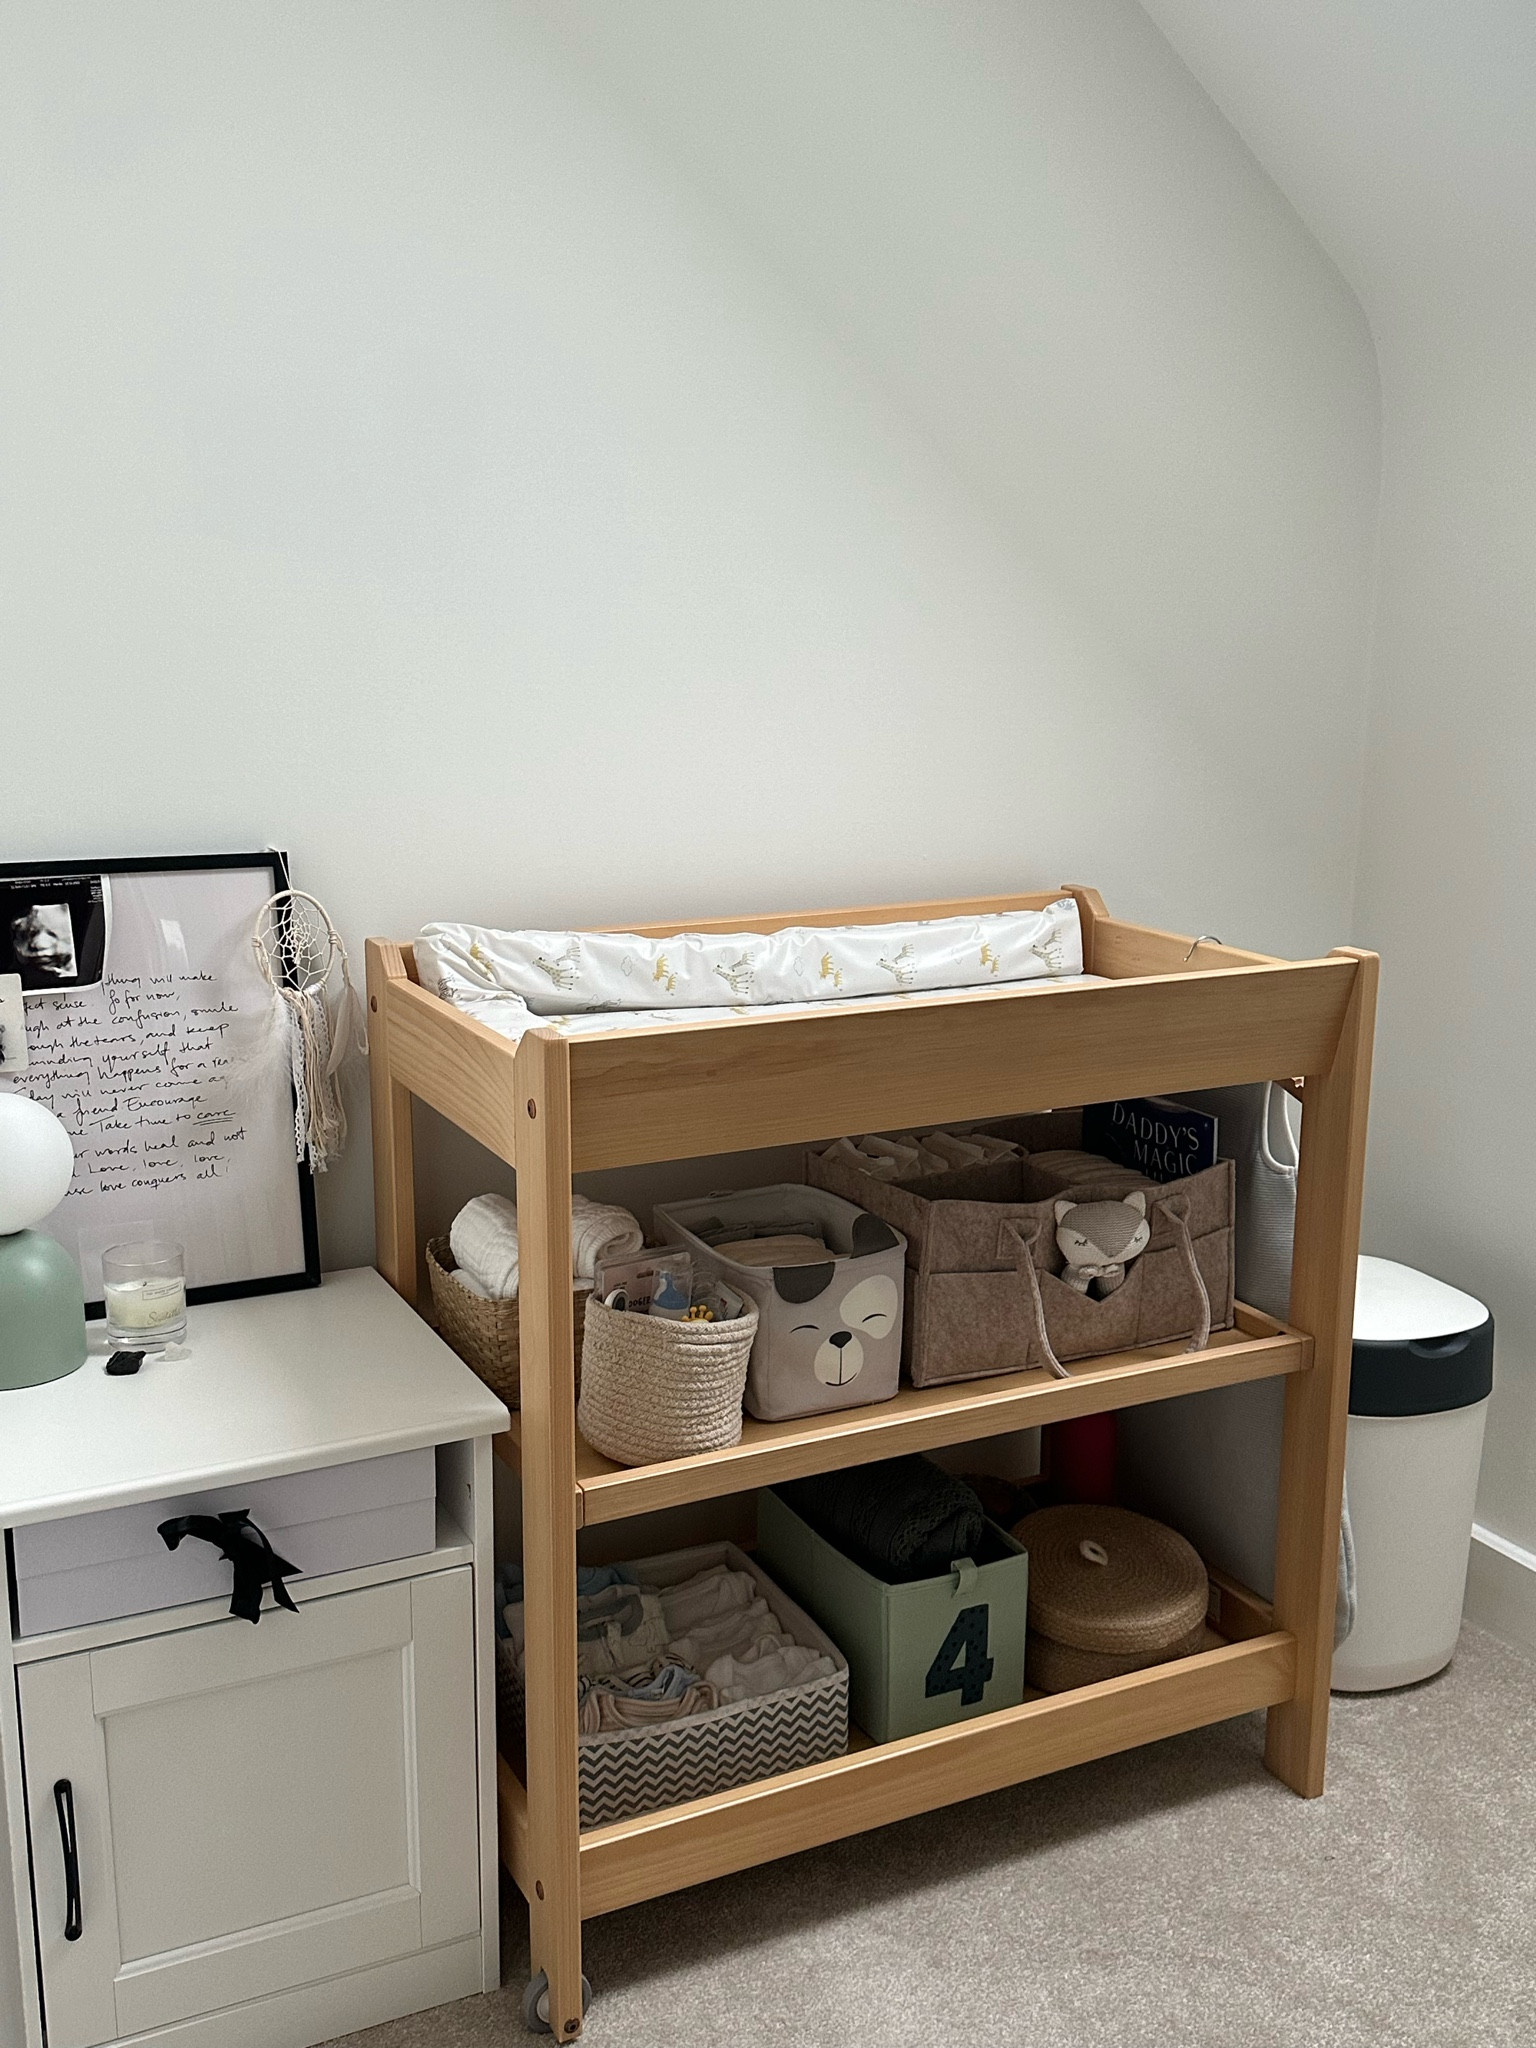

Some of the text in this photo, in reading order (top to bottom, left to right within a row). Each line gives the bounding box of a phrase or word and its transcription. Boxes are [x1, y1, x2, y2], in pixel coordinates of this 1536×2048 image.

[150, 974, 172, 984] will
[179, 970, 217, 981] make
[23, 997, 46, 1016] fect
[125, 989, 140, 1009] for
[25, 1020, 49, 1038] ugh
[57, 1016, 74, 1030] at
[78, 1016, 102, 1027] the
[191, 1002, 238, 1015] smile
[28, 1039, 63, 1054] ough
[69, 1036, 94, 1048] the
[146, 1024, 176, 1038] and
[187, 1023, 229, 1038] keep
[102, 1041, 169, 1073] yourself
[179, 1037, 213, 1053] that
[13, 1070, 90, 1088] everything
[97, 1066, 161, 1082] happens
[170, 1057, 193, 1077] for
[62, 1089, 92, 1099] will
[100, 1083, 150, 1095] never
[155, 1079, 203, 1088] come
[123, 1096, 208, 1112] Encourage
[89, 1115, 132, 1133] Take
[135, 1115, 172, 1128] time
[176, 1113, 191, 1122] to
[1112, 1102, 1200, 1151] DADDY'S
[95, 1139, 137, 1157] words
[144, 1135, 179, 1152] heal
[187, 1131, 215, 1148] and
[223, 1126, 247, 1141] not
[1133, 1139, 1199, 1175] MAGIC
[100, 1180, 127, 1193] love
[132, 1173, 187, 1190] conquers
[925, 1603, 994, 1707] 4
